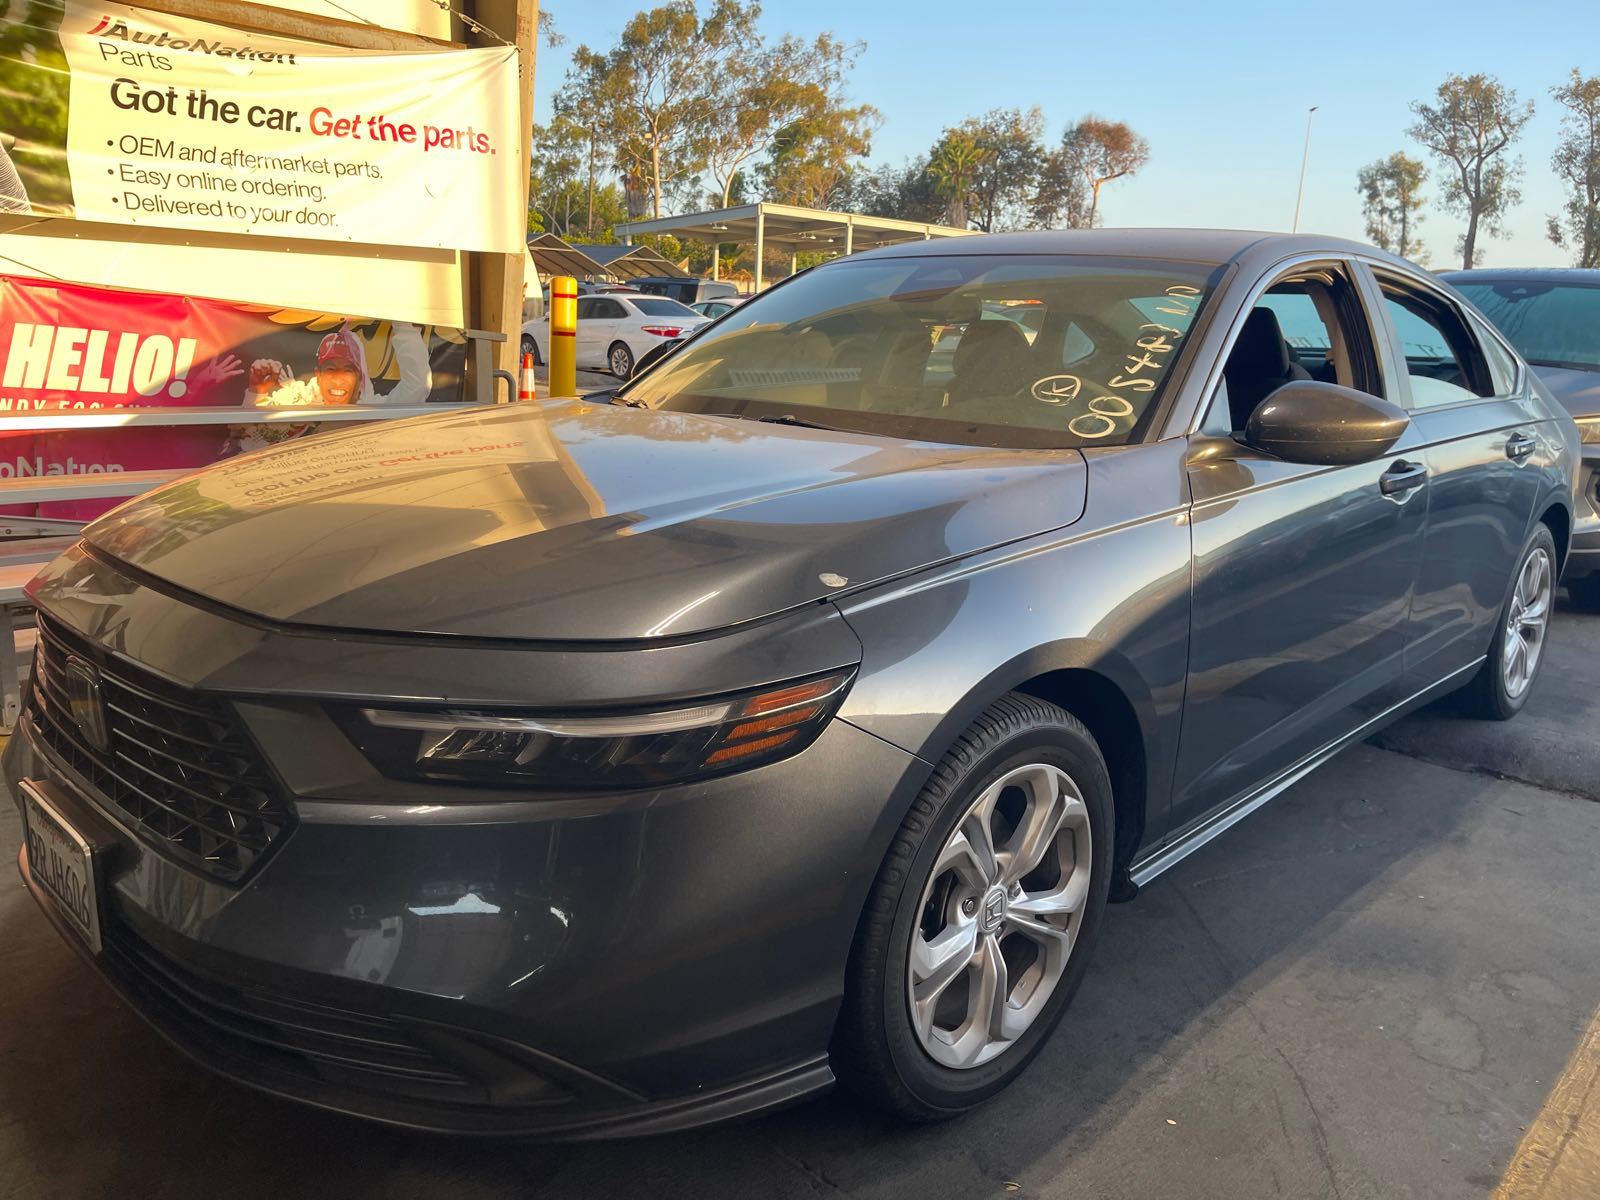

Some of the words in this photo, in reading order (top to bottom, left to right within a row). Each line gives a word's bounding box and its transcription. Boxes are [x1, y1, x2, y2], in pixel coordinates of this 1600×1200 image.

[98, 41, 173, 71] Parts
[110, 77, 178, 116] Got
[186, 90, 240, 124] the
[247, 105, 301, 133] car.
[309, 106, 362, 140] Get
[367, 115, 417, 144] the
[423, 125, 497, 155] parts.
[119, 135, 175, 159] OEM
[178, 145, 217, 164] and
[220, 149, 330, 175] aftermarket
[334, 160, 384, 180] parts.
[119, 163, 172, 190] Easy
[176, 170, 238, 193] online
[241, 177, 328, 204] ordering.
[123, 191, 223, 218] Delivered
[226, 201, 247, 220] to
[250, 206, 293, 224] your
[295, 206, 339, 228] door.
[2, 322, 198, 399] HELIO!
